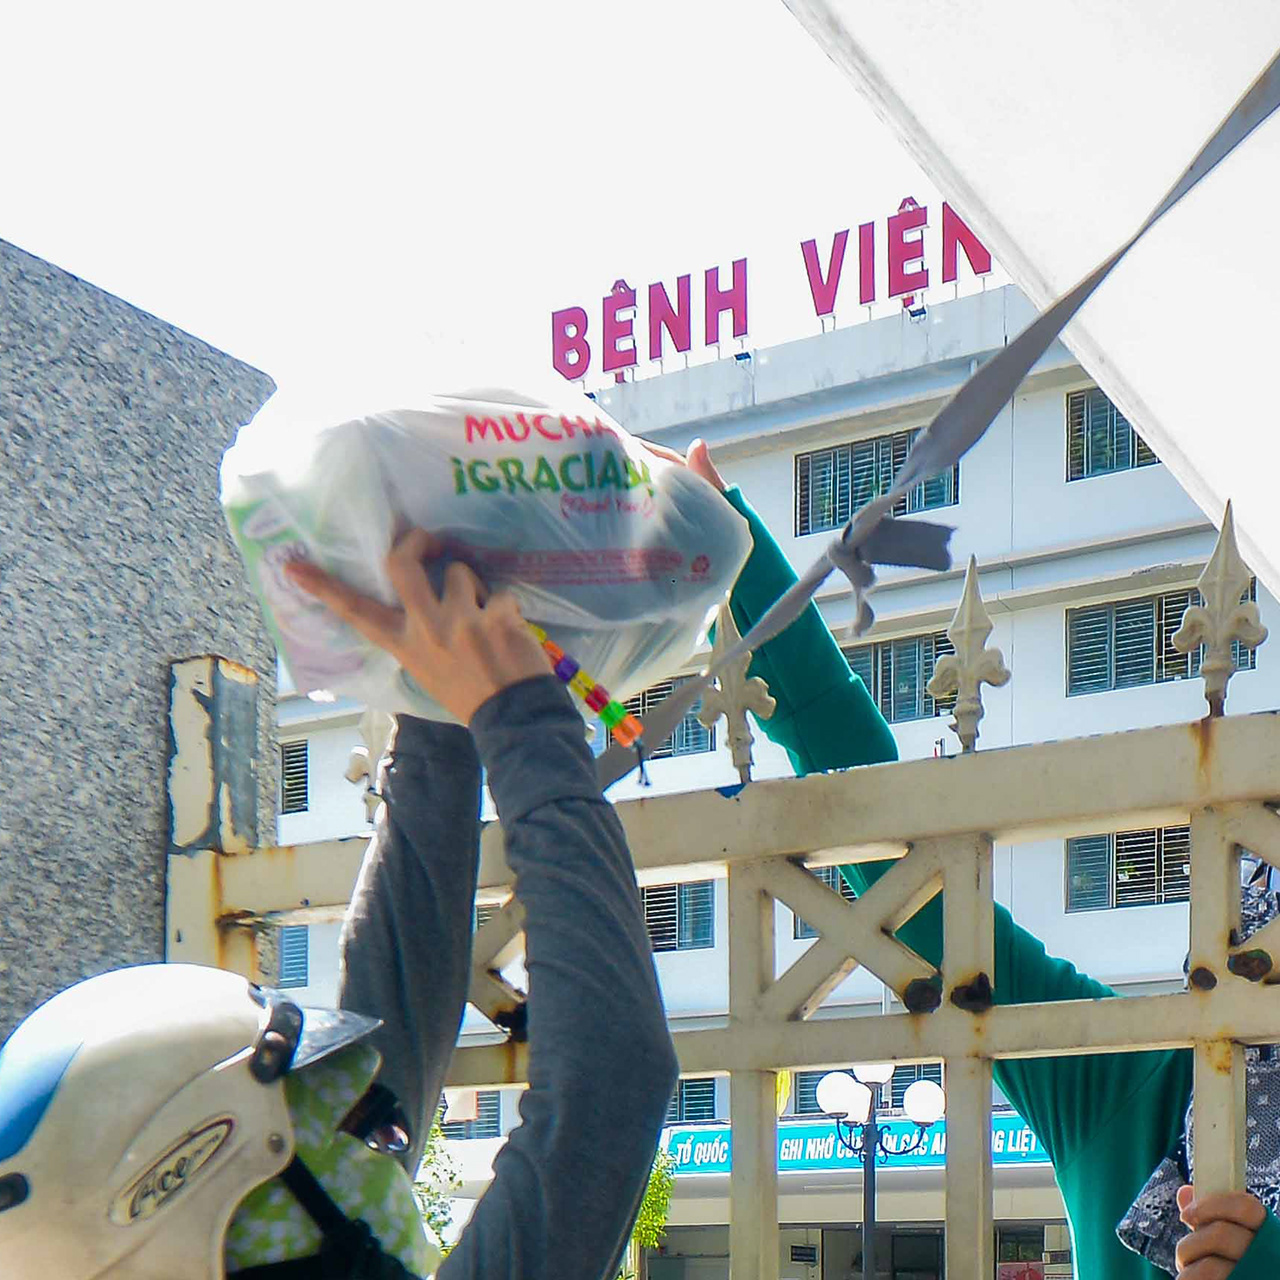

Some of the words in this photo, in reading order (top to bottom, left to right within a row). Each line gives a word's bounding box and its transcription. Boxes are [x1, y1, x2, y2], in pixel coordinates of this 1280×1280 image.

[552, 257, 748, 383] BỆNH
[800, 196, 992, 317] VIỆN
[465, 411, 619, 444] MUCHA
[694, 1134, 728, 1165] QUỐC
[780, 1138, 804, 1160] GHI
[806, 1133, 835, 1160] NHỚ
